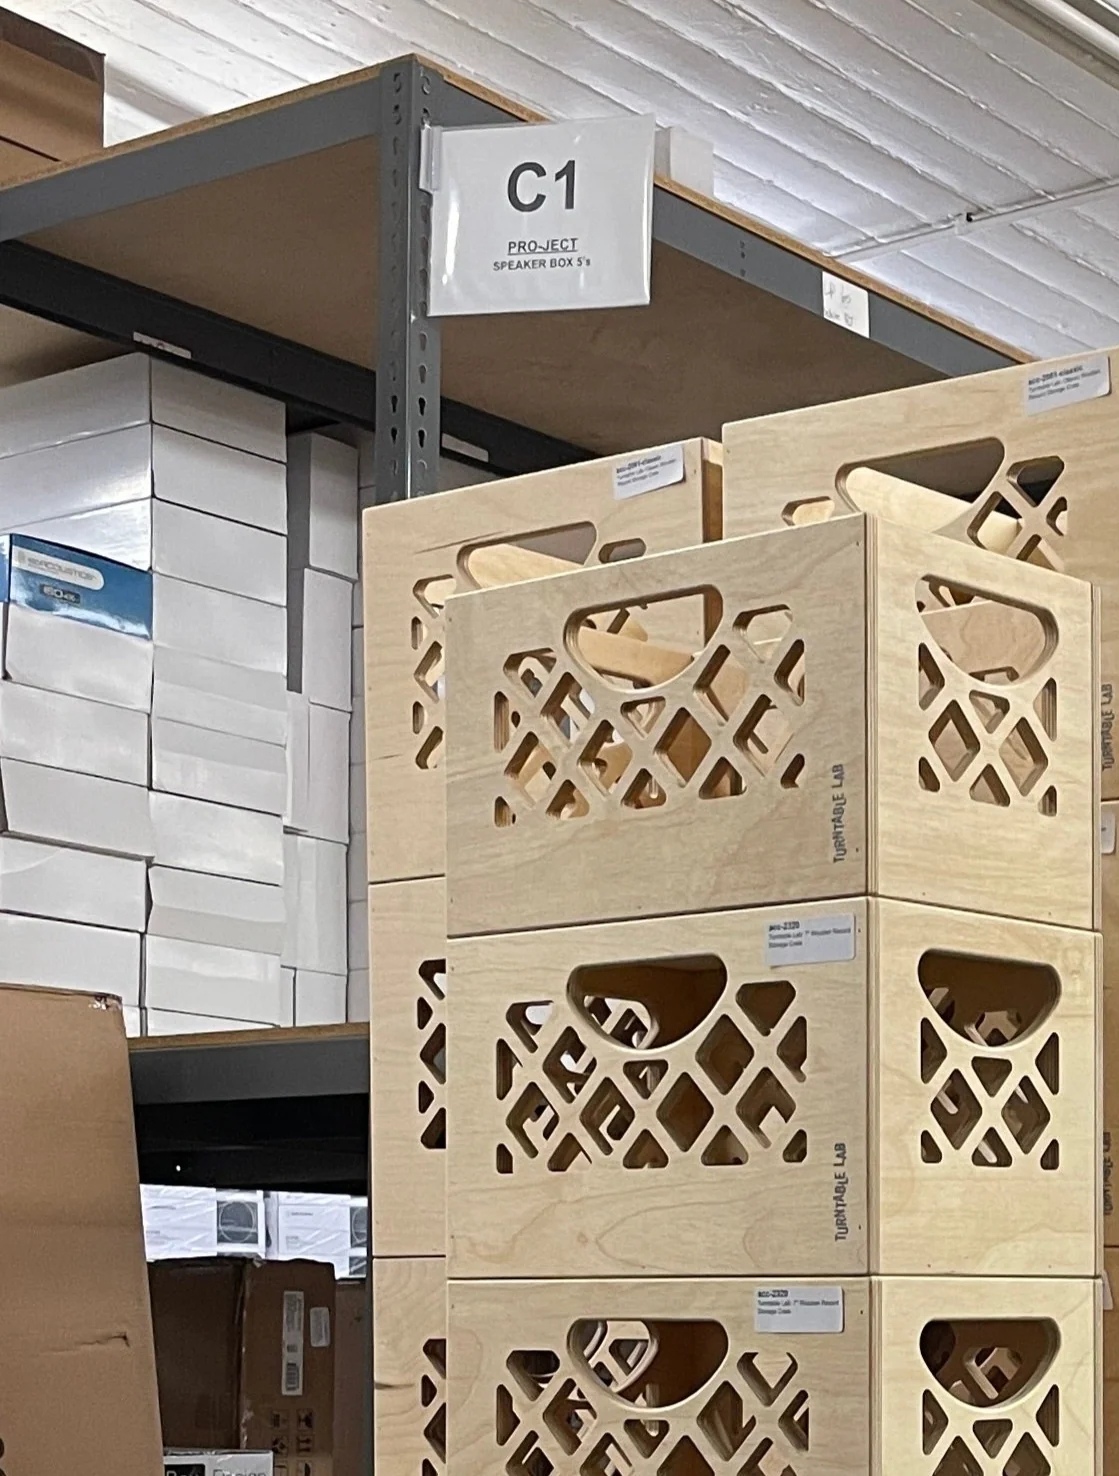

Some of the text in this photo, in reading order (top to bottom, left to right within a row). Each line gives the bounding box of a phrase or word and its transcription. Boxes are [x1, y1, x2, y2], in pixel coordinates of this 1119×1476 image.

[507, 160, 576, 212] C1
[508, 238, 578, 253] PRO-JECT
[493, 259, 546, 271] SPEAKER
[550, 258, 574, 268] BOX
[1101, 684, 1113, 706] LAB
[832, 764, 847, 863] TURNTABLE LAB
[833, 1143, 849, 1241] TURNTABLE LAB
